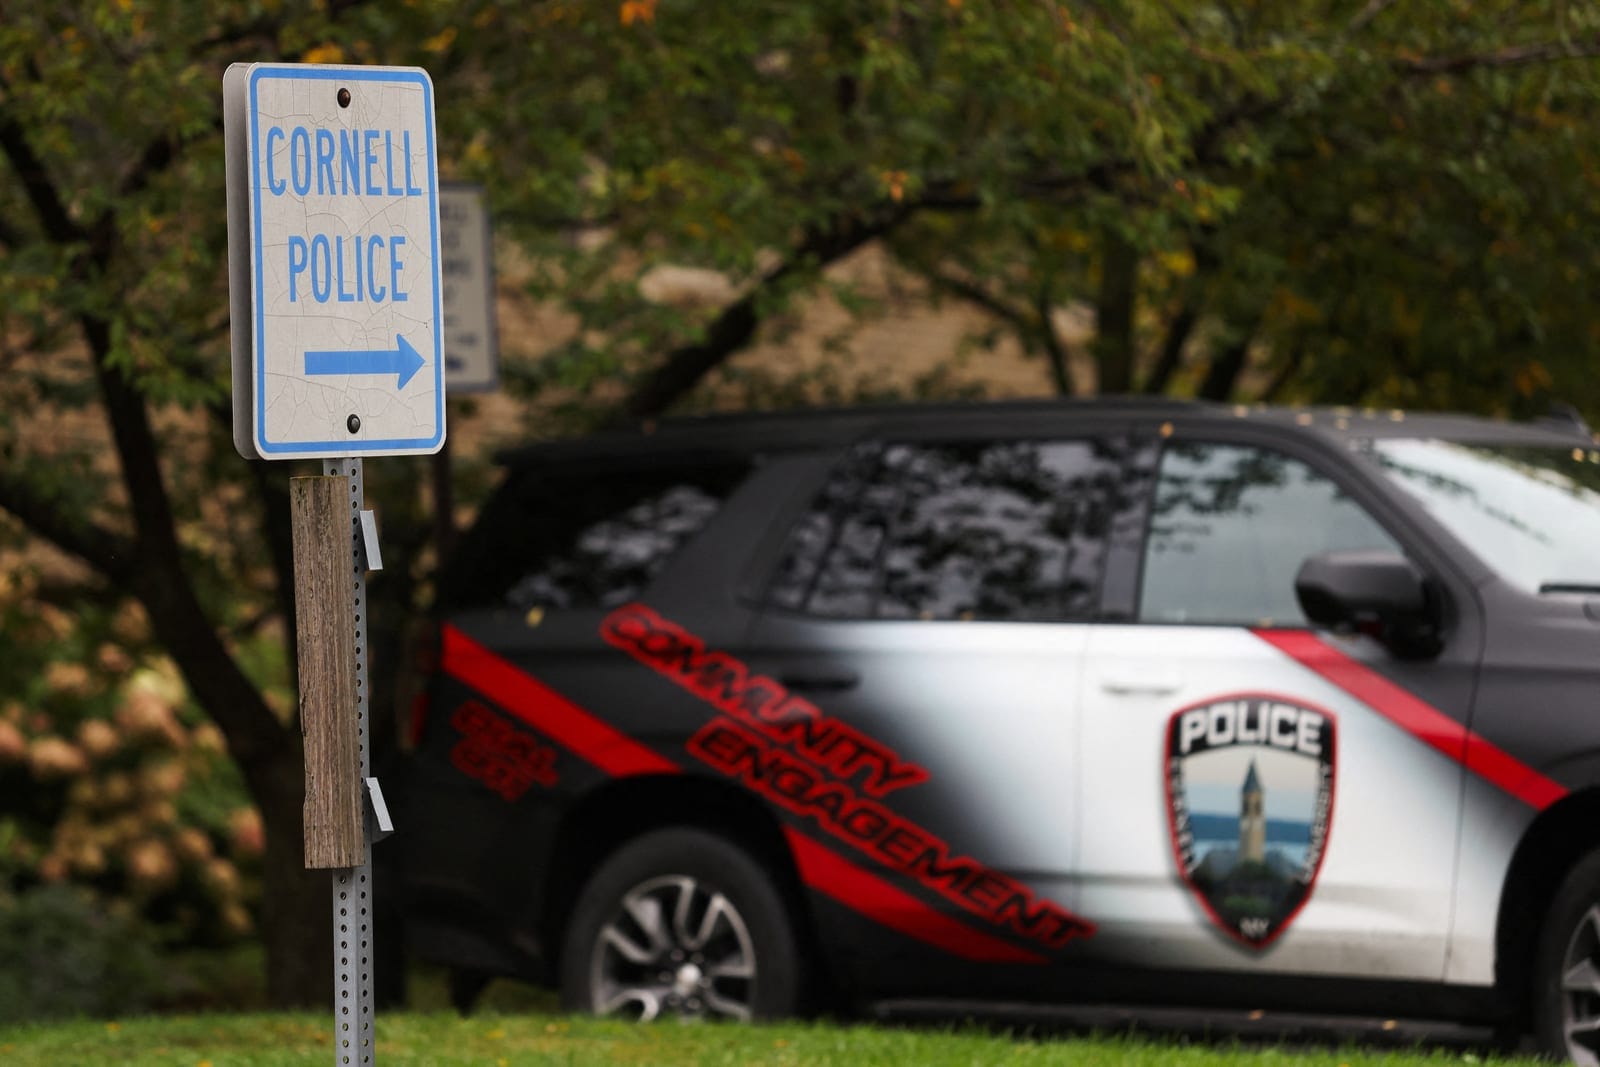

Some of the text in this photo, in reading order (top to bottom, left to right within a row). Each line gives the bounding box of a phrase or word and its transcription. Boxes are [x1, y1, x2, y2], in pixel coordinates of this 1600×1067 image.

[265, 126, 422, 197] CORNELL
[288, 234, 409, 304] POLICE
[603, 606, 927, 795] COMMUNITY
[1179, 701, 1324, 754] POLICE
[691, 719, 1095, 946] ENGAGEMENT
